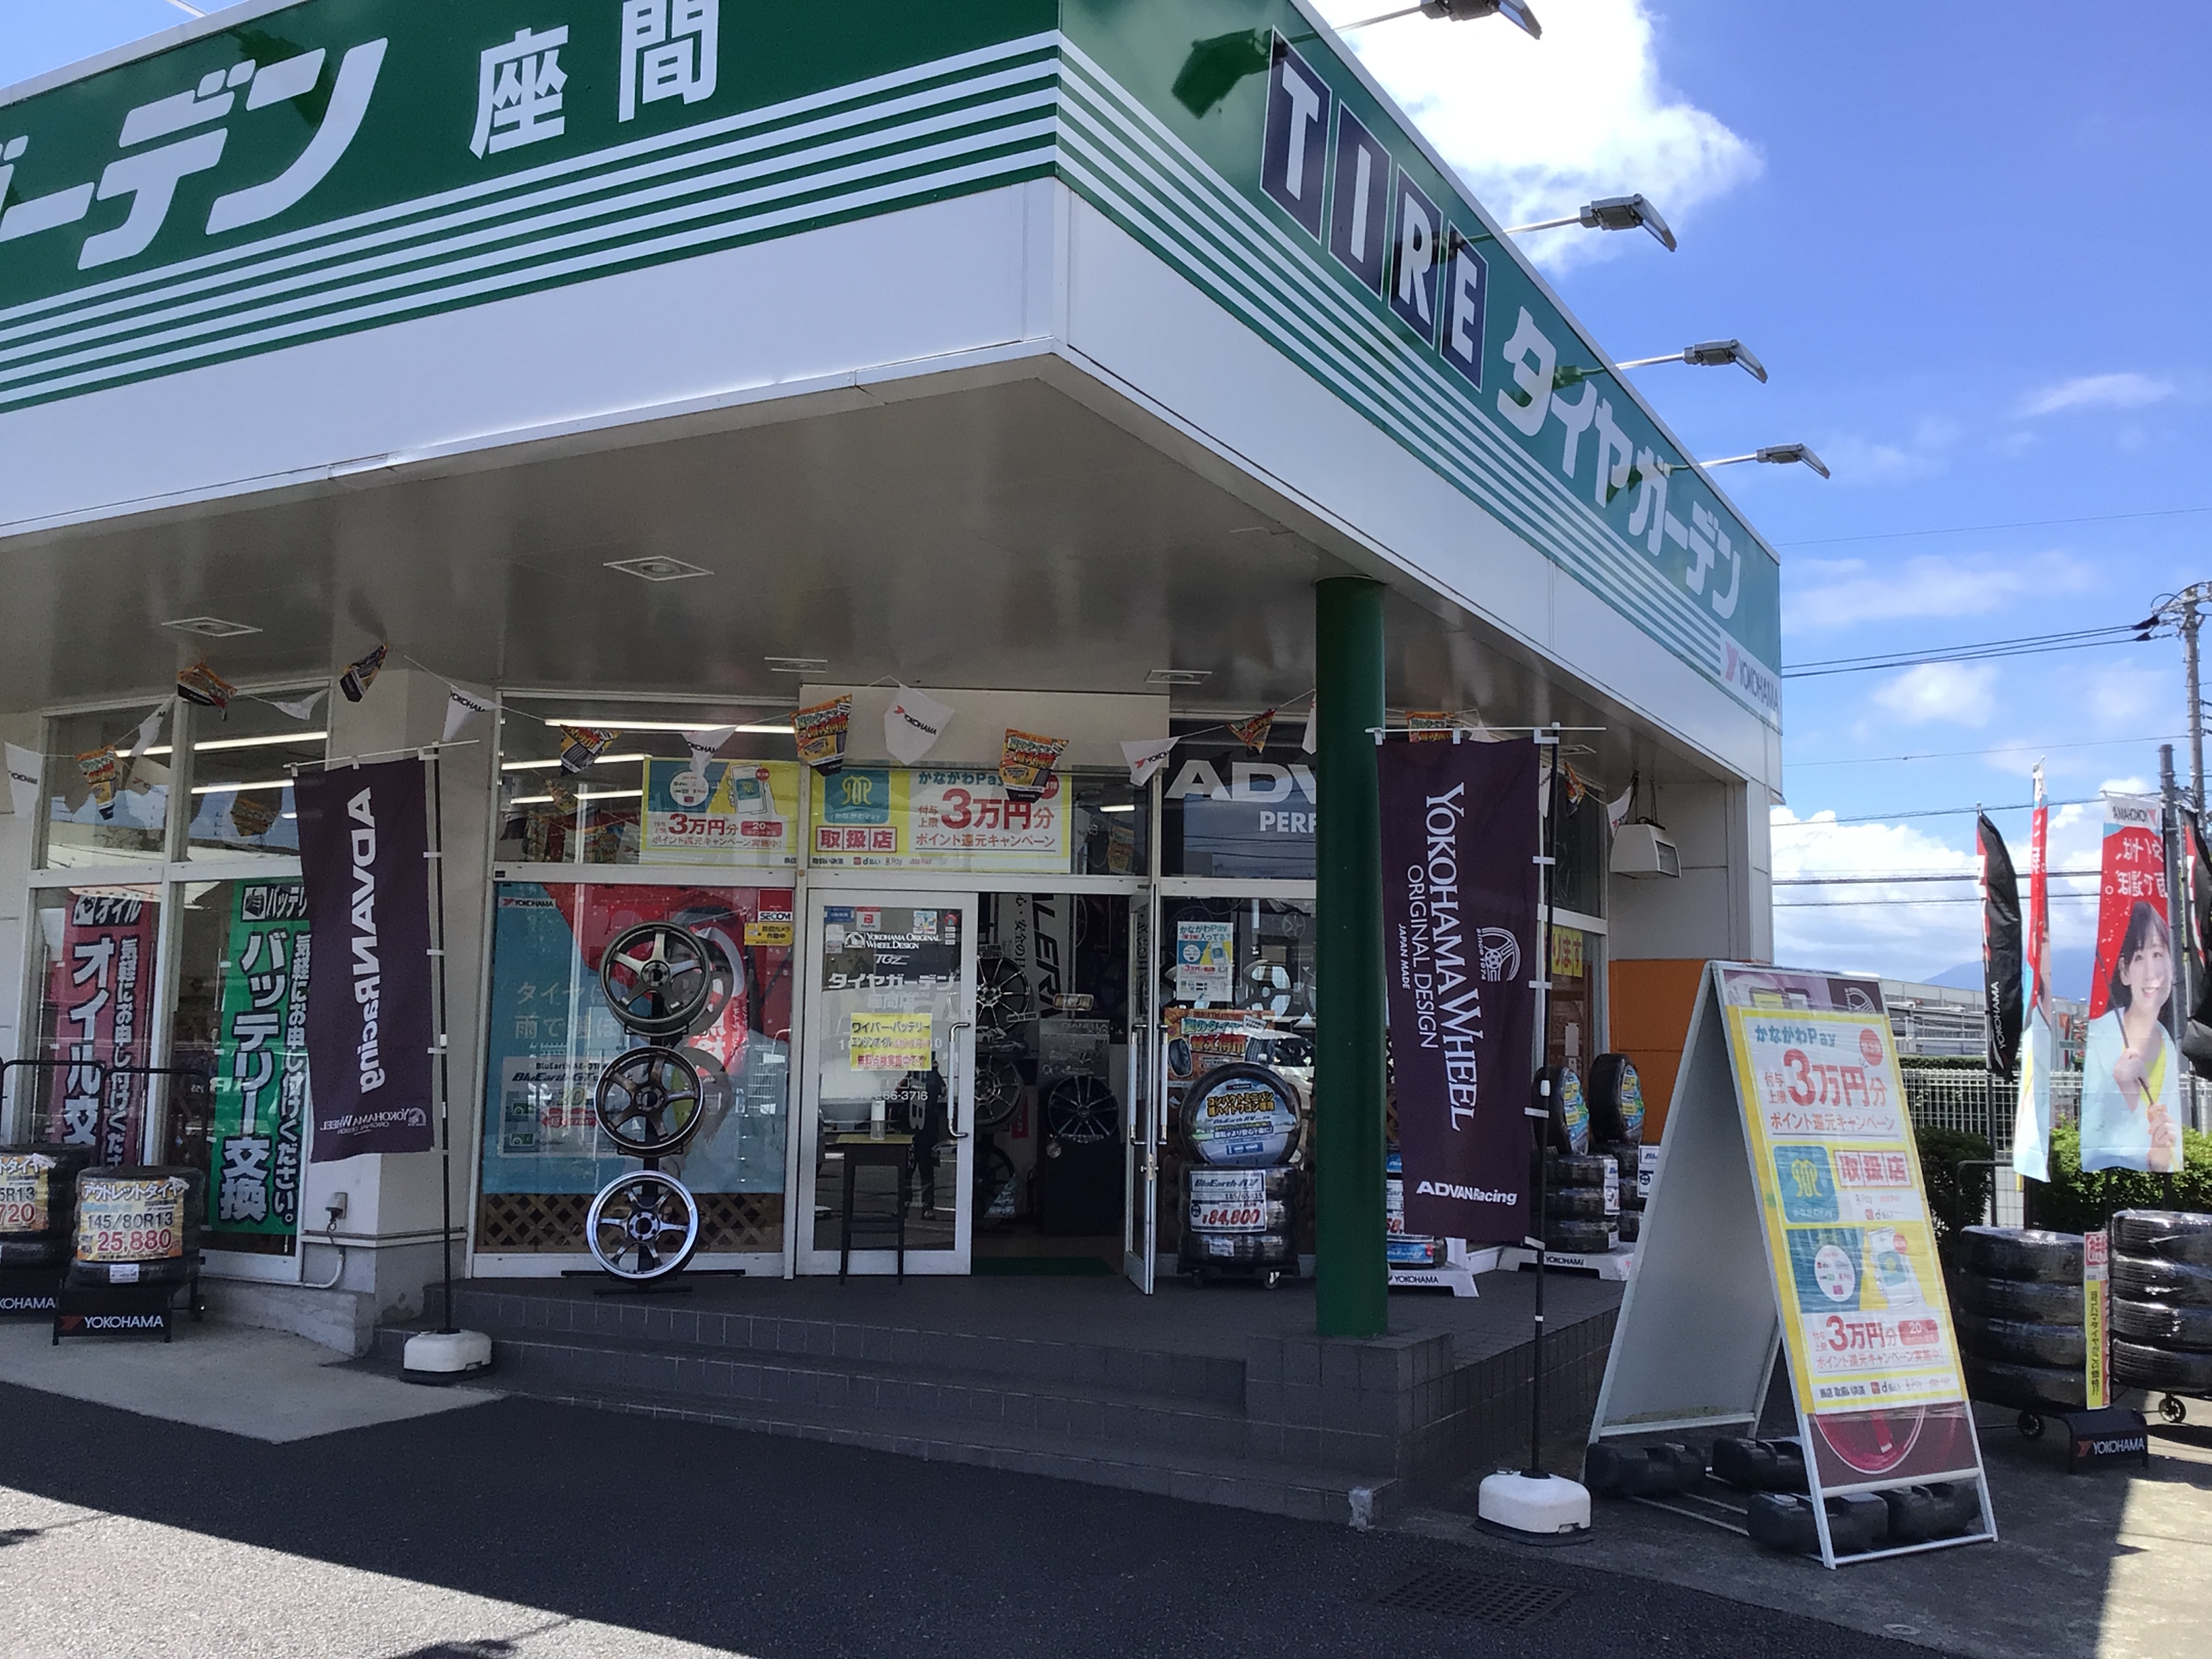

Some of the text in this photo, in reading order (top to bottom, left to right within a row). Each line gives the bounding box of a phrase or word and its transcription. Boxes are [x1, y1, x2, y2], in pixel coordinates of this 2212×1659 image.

[0, 0, 720, 270] ーデン 座間
[1279, 60, 1478, 363] TIRE
[1496, 306, 1740, 619] タイヤガーデン
[1738, 657, 1779, 715] YOKOHAMA
[904, 714, 937, 736] YOKOHAMA
[941, 787, 1054, 831] 3万円分
[668, 813, 739, 836] 3万円分
[821, 830, 893, 848] 取扱店
[916, 834, 1055, 848] ポイント還元キャンペーン
[95, 898, 143, 923] オイル
[760, 912, 791, 920] SECOM
[866, 933, 941, 942] YOKOHAMA ORIGINAL
[866, 940, 919, 949] WHEEL DESIGN
[1398, 923, 1410, 989] JAPAN MADE
[1407, 864, 1439, 1050] ORIGINAL DESIGN
[828, 972, 955, 991] タイヤガーデン
[1990, 980, 2007, 1050] YOKOHAMA
[1755, 1025, 1836, 1047] かながわPay
[220, 932, 290, 1222] バッテリー交換
[1783, 1048, 1887, 1107] 3万円分
[1770, 1111, 1896, 1131] ポイント還元キャンペーン
[1839, 1155, 1908, 1183] 取扱店
[87, 1212, 173, 1229] 145/80R13
[1395, 1275, 1439, 1284] YOKOHAMA
[84, 1315, 164, 1328] YOKOHAMA
[1826, 1315, 1898, 1352] 3万円分
[2093, 1437, 2145, 1455] YOKOHAMA
